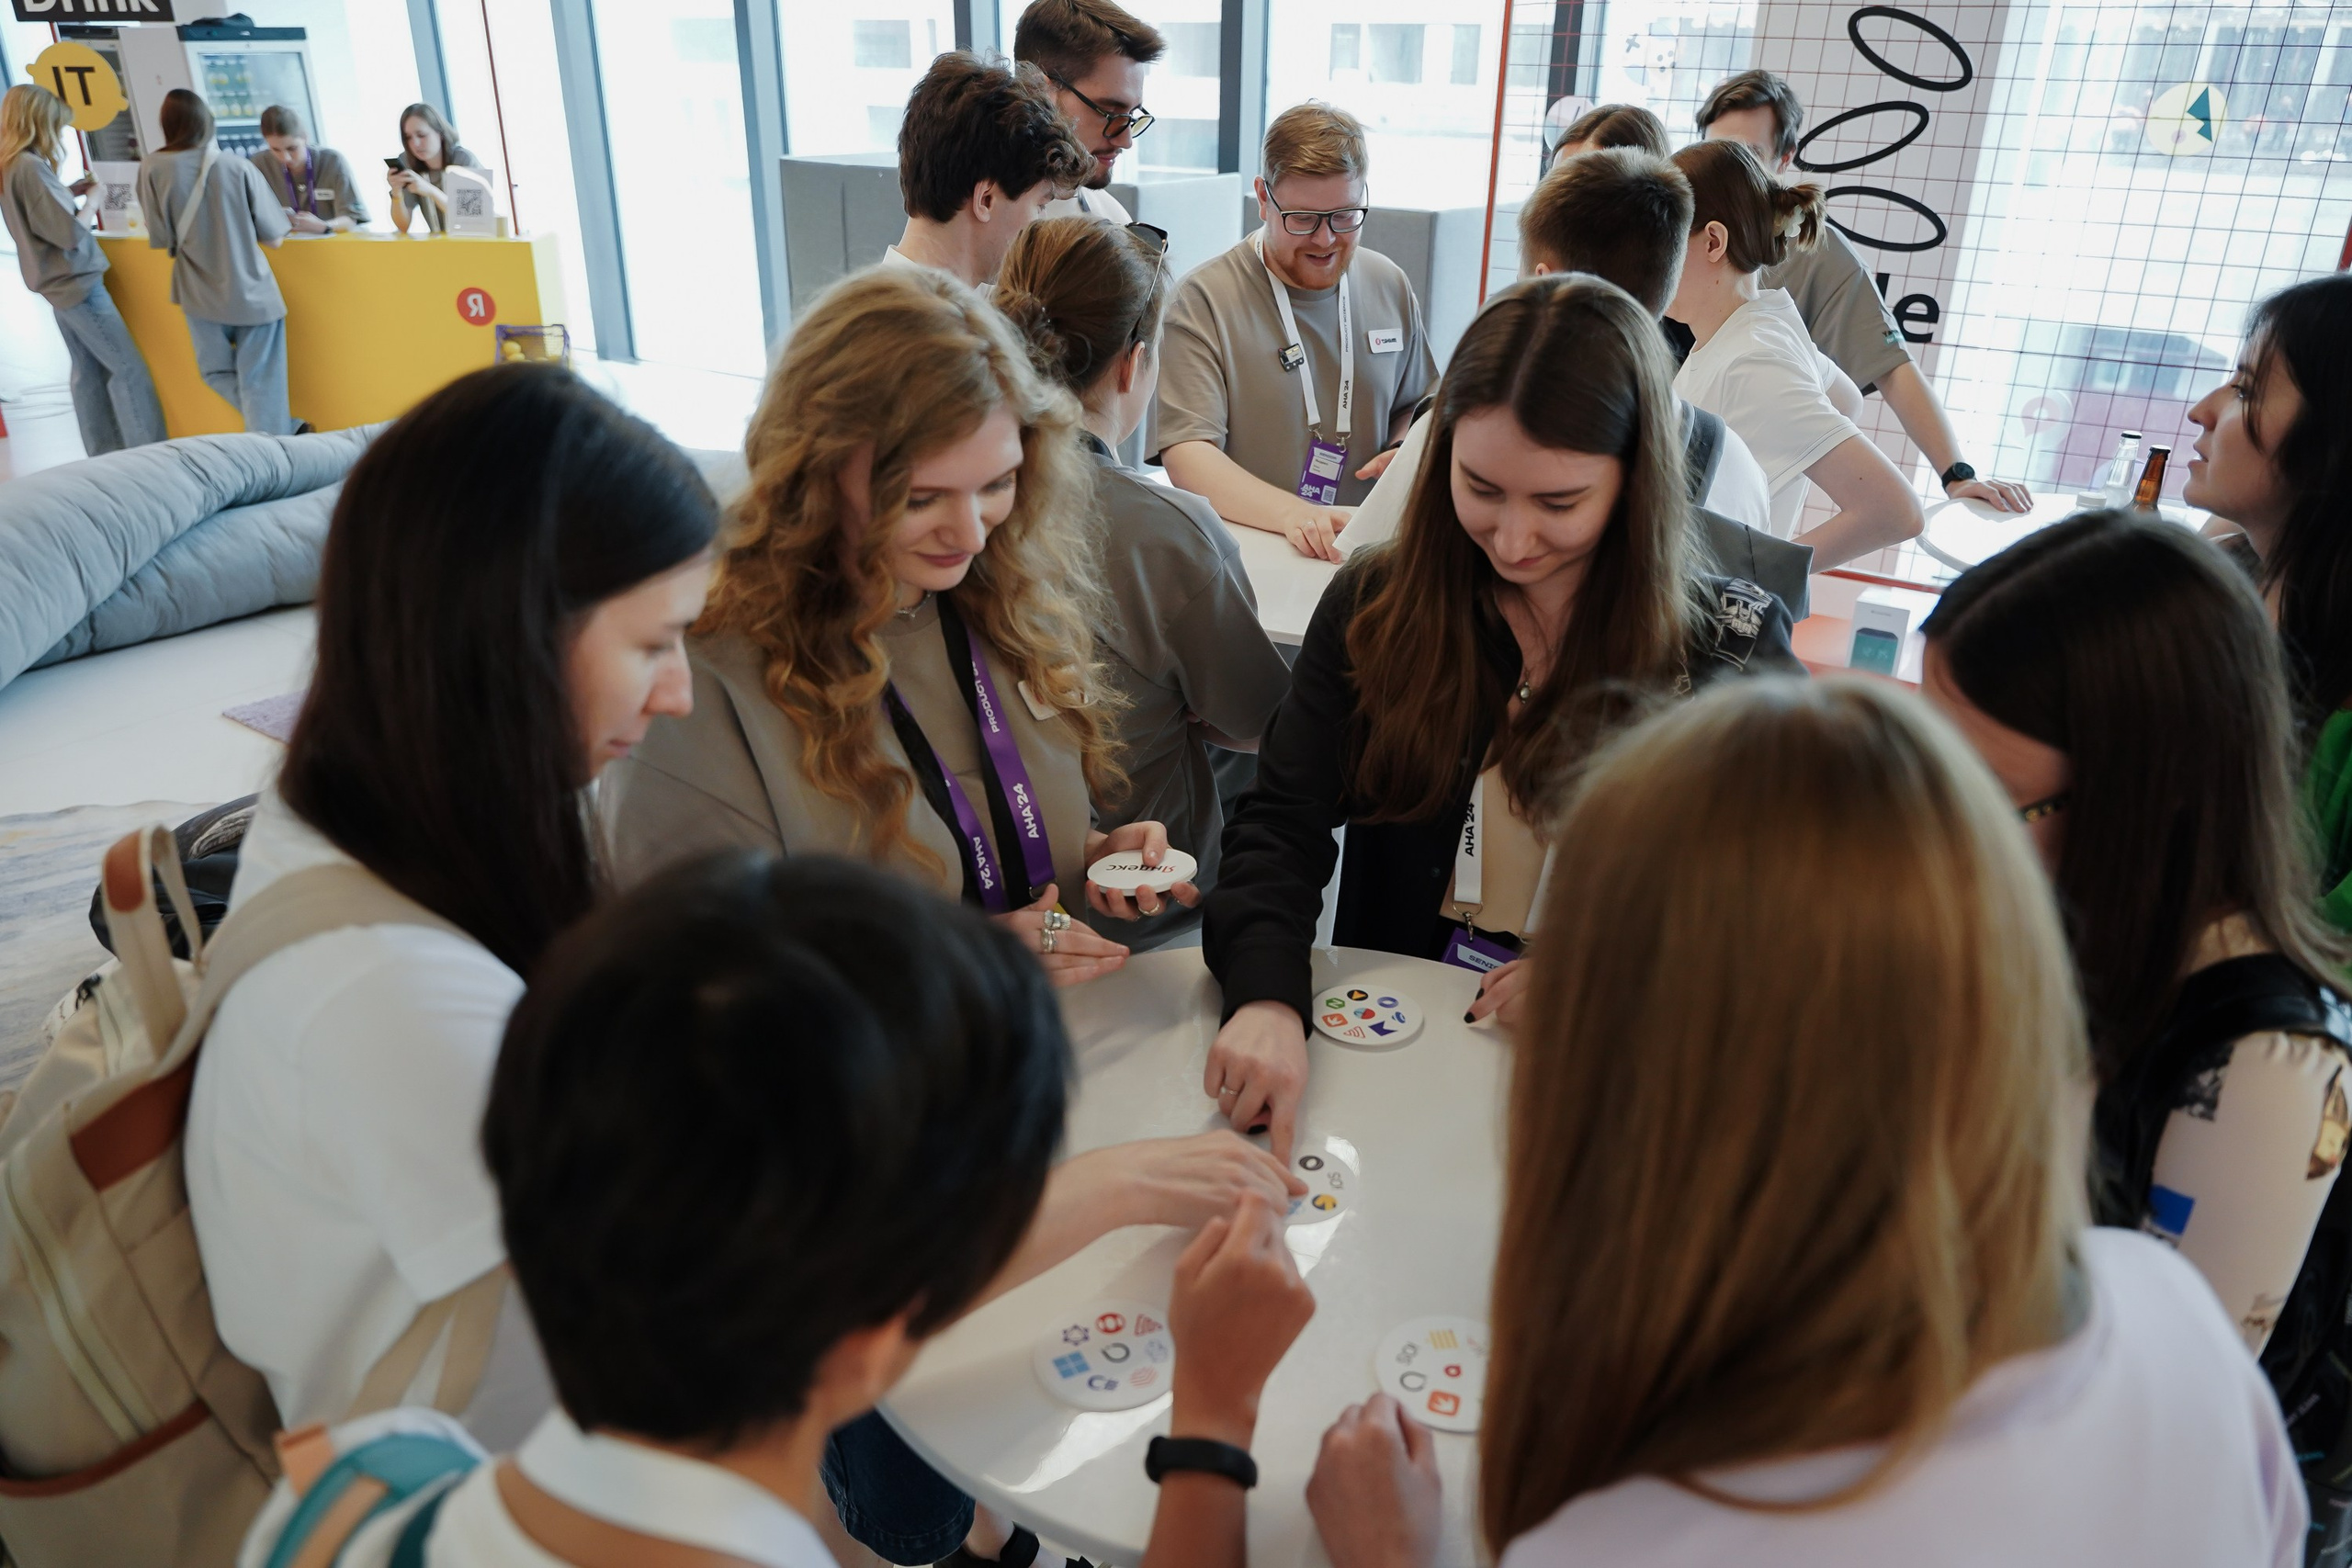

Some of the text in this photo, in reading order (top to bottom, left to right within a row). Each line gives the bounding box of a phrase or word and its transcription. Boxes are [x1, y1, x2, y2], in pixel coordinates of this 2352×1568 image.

[51, 66, 96, 106] IT
[1300, 484, 1321, 495] AHA
[975, 680, 1001, 734] PRODUCT
[1468, 954, 1498, 970] SENI
